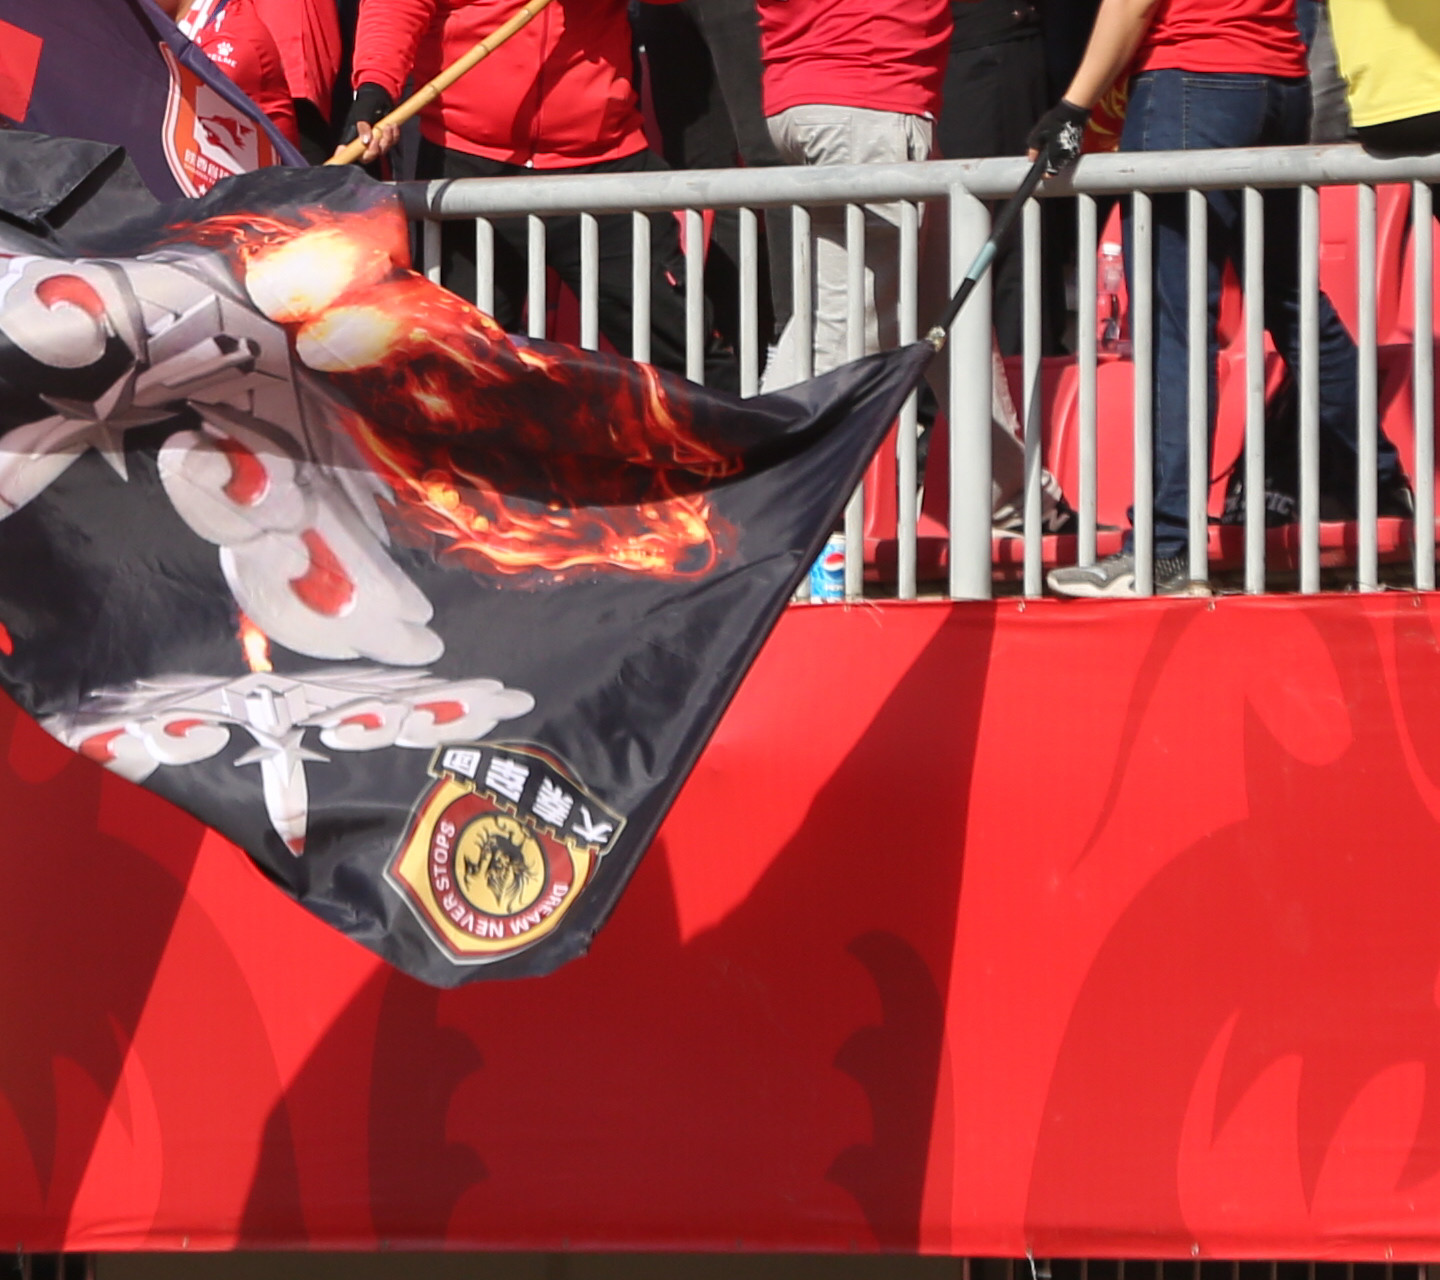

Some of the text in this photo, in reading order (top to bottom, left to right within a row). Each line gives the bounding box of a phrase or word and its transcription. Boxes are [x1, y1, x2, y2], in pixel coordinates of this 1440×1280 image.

[442, 746, 615, 844] 大秦军团
[433, 819, 570, 939] DREAM NEVER STOPS
